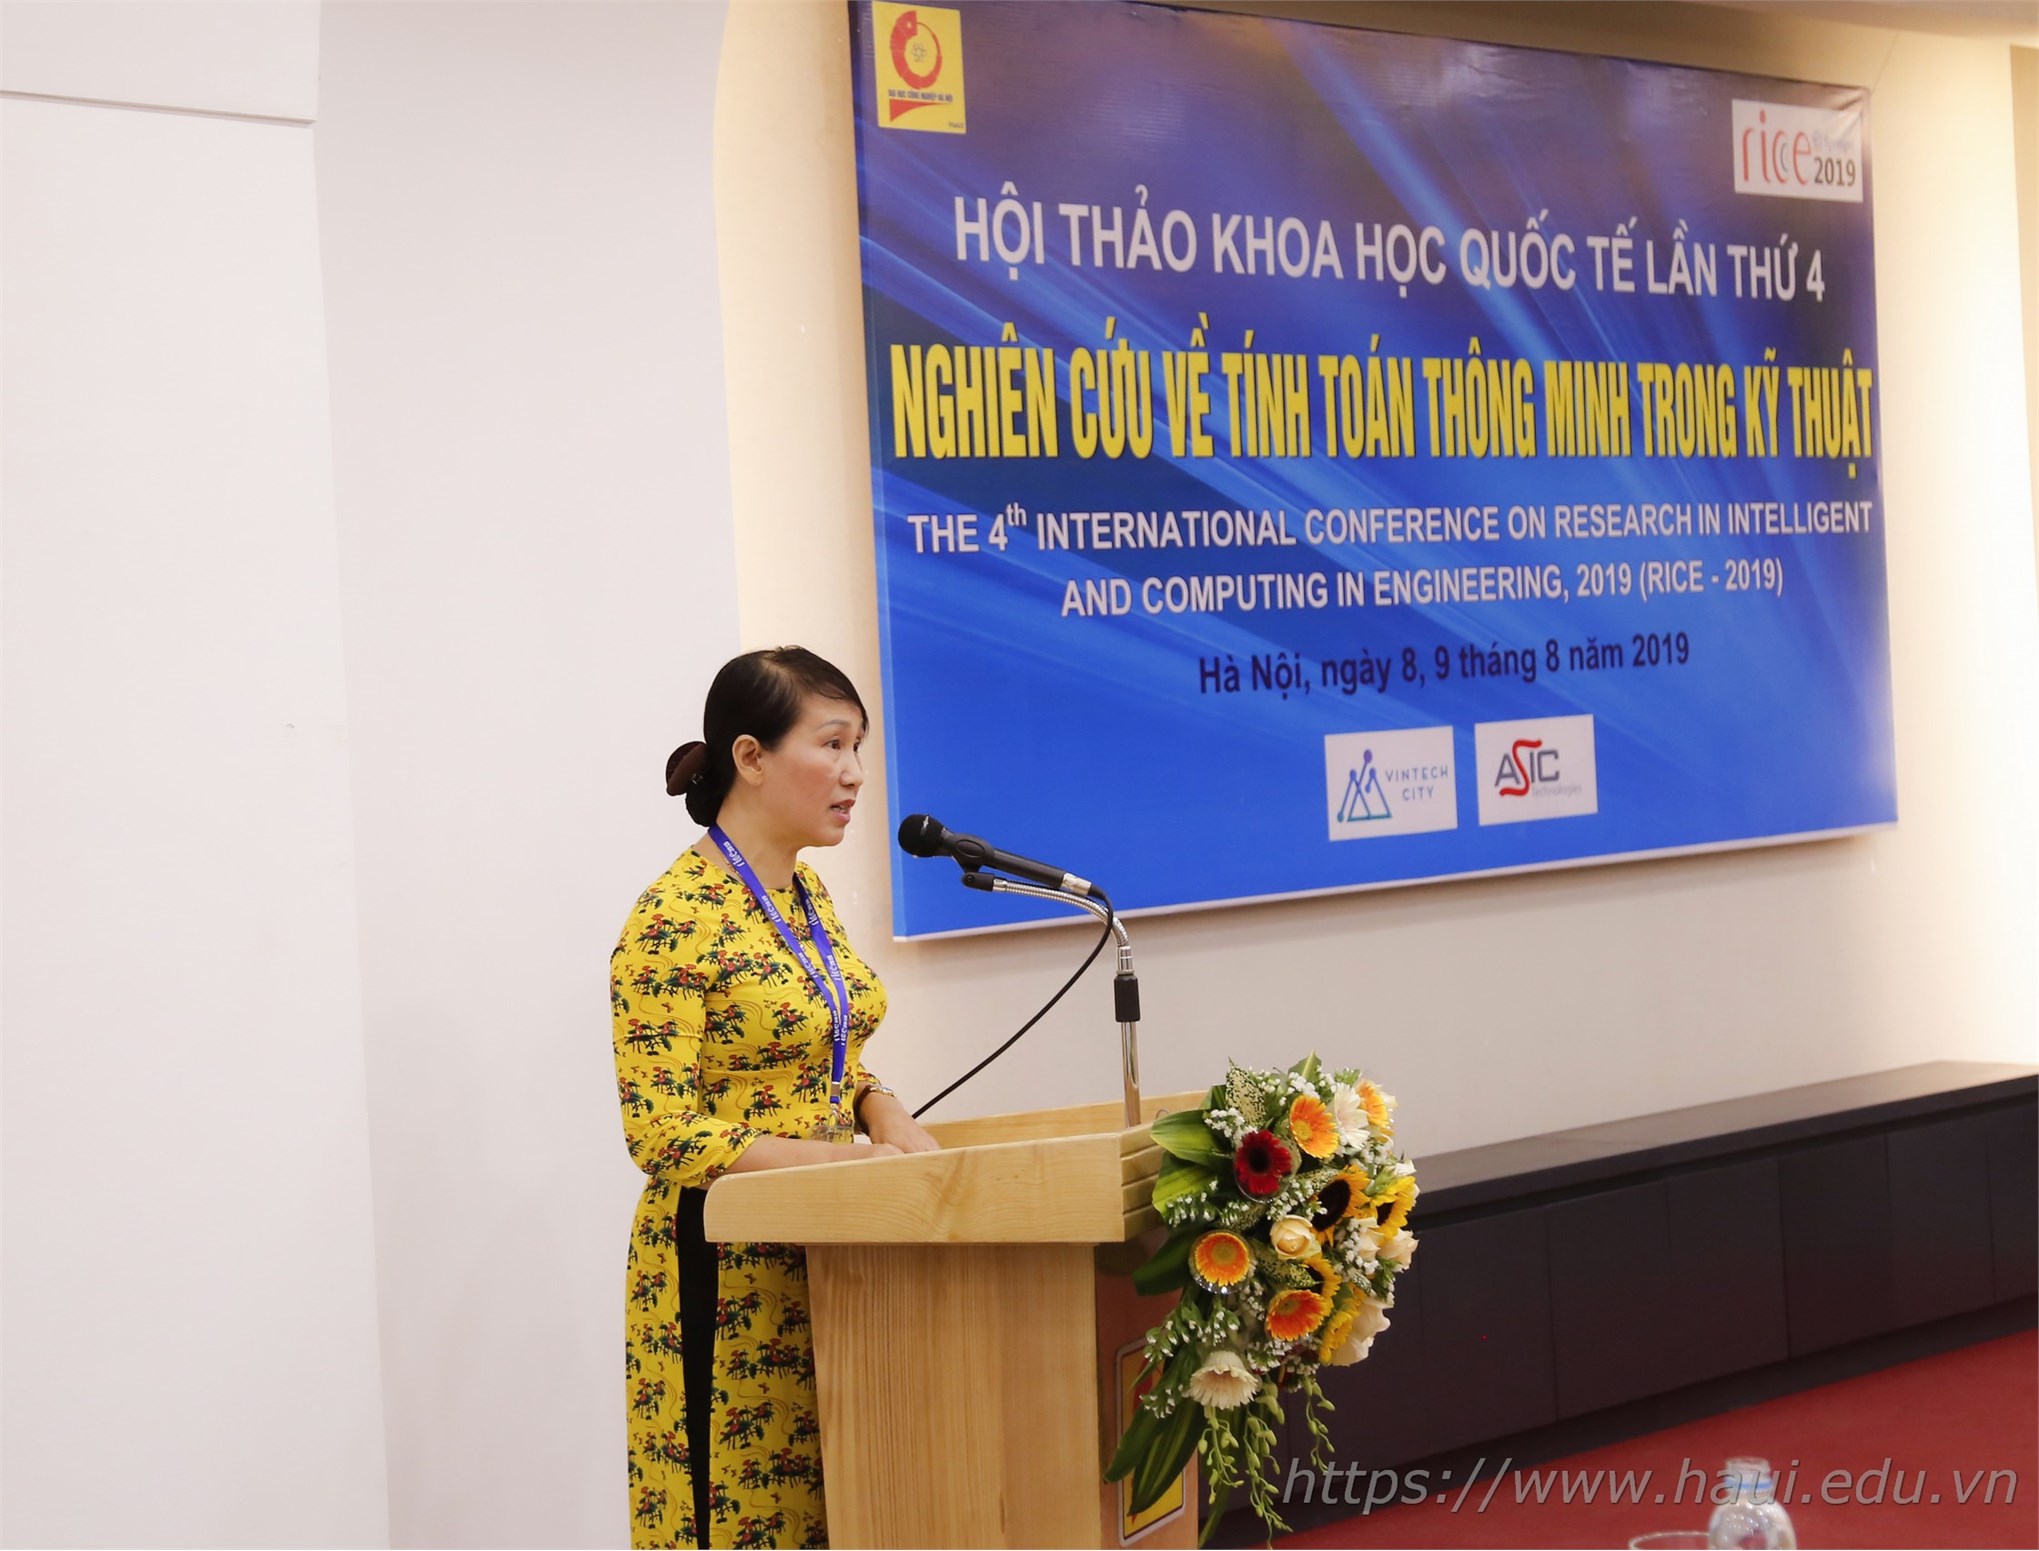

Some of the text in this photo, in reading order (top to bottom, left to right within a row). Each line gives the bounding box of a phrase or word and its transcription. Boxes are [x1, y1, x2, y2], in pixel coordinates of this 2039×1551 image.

[1814, 156, 1857, 187] 2019
[953, 181, 1826, 302] HỘI THẢO KHOA HỌC QUỐC TẾ LẦN THỨ 4
[890, 312, 1873, 479] NGHIÊN CỨU VỀ TÍNH TOÁN THÔNG MINH TRONG KỸ THUẬT
[907, 500, 1874, 554] THE 4th INTERNATIONAL CONFERENCE ON RESEARCH IN INTELLIGENT
[1060, 577, 1133, 618] AND
[1141, 572, 1329, 615] COMPUTING
[1336, 571, 1366, 607] IN
[1373, 564, 1570, 606] ENGINEERING,
[1575, 561, 1632, 599] 2019
[1638, 559, 1705, 603] (RICE
[1724, 557, 1784, 598] 2019)
[1199, 631, 1690, 700] Hà Nội, ngày 8, 9 tháng 8 năm 2019
[1384, 765, 1449, 783] VINTECH
[1402, 785, 1435, 802] CITY
[1494, 739, 1561, 797] ASIC
